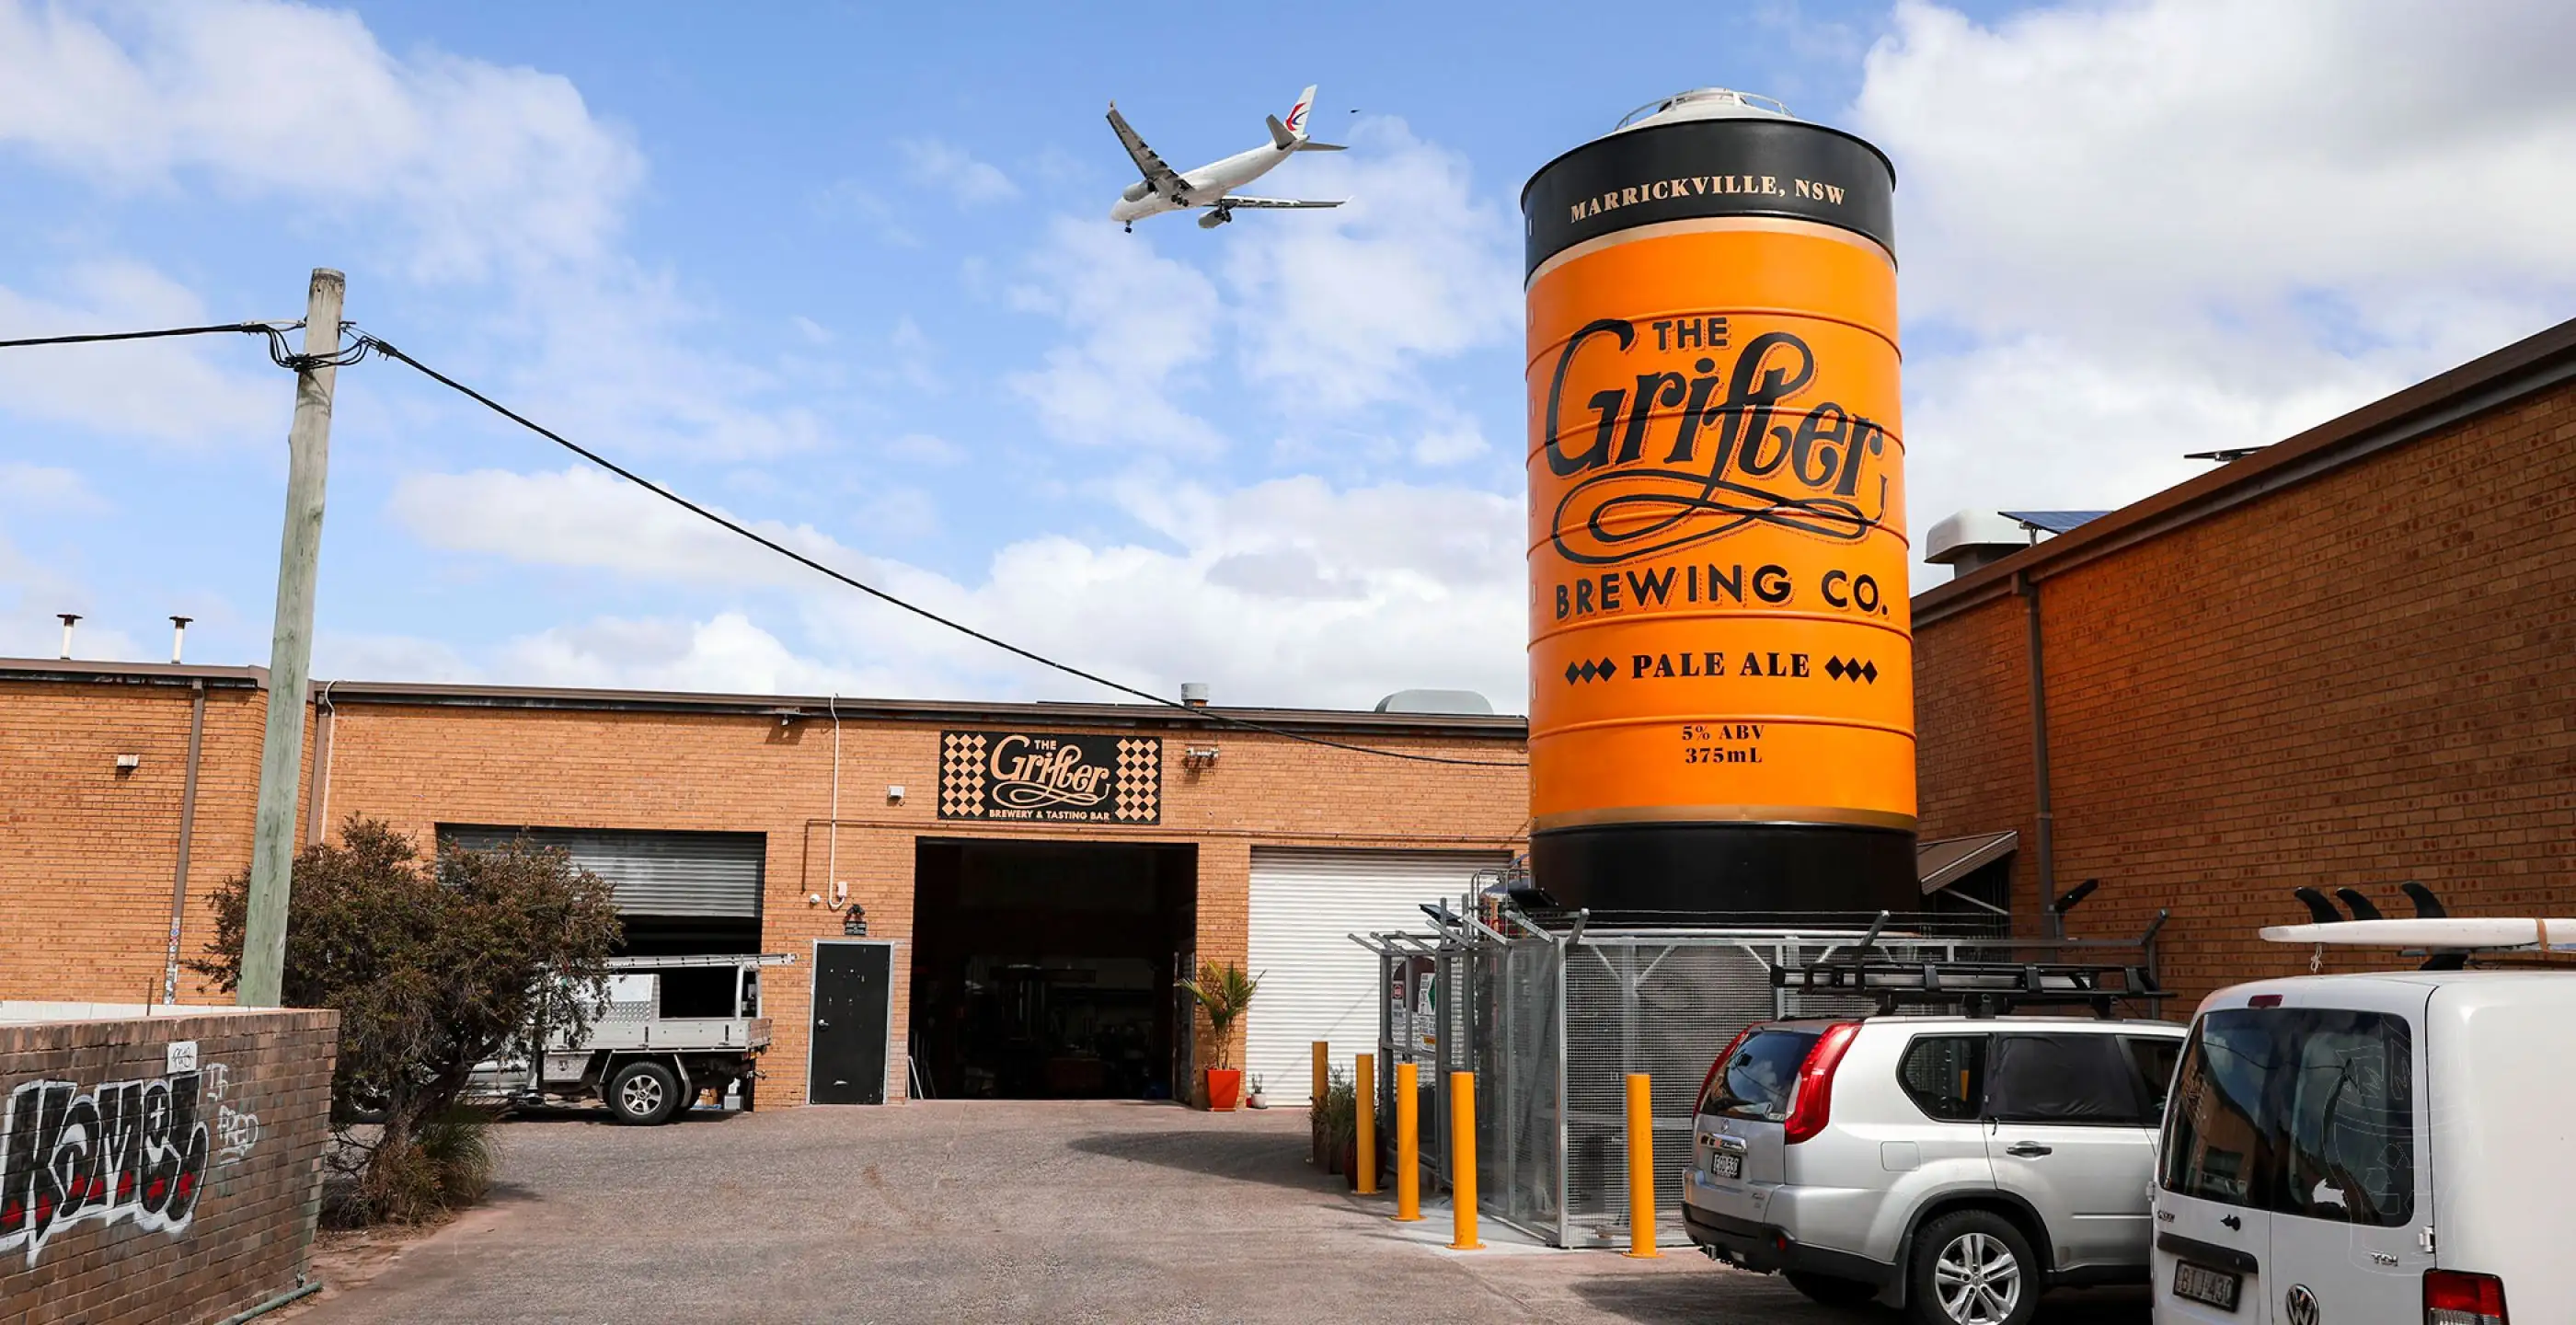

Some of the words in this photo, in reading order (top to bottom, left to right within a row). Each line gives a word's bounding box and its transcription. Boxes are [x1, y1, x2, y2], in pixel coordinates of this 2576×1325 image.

[1570, 175, 1786, 224] MARRICKVILLE,
[1795, 179, 1846, 206] NSW
[1652, 317, 1731, 352] THE
[1546, 318, 1888, 563] Grifter
[1556, 564, 1794, 621] BREWING
[1821, 570, 1889, 619] CO.
[1631, 651, 1726, 679] PALE
[1740, 651, 1811, 678] ALE
[1034, 739, 1057, 751] THE
[1682, 725, 1710, 742] 5%
[1719, 724, 1765, 741] ABV
[1685, 746, 1763, 764] 375mL
[990, 735, 1111, 809] Grifter
[989, 809, 1033, 818] BREWERY
[1036, 810, 1043, 818] &
[1046, 811, 1087, 820] TASTING
[1089, 812, 1110, 821] BAR
